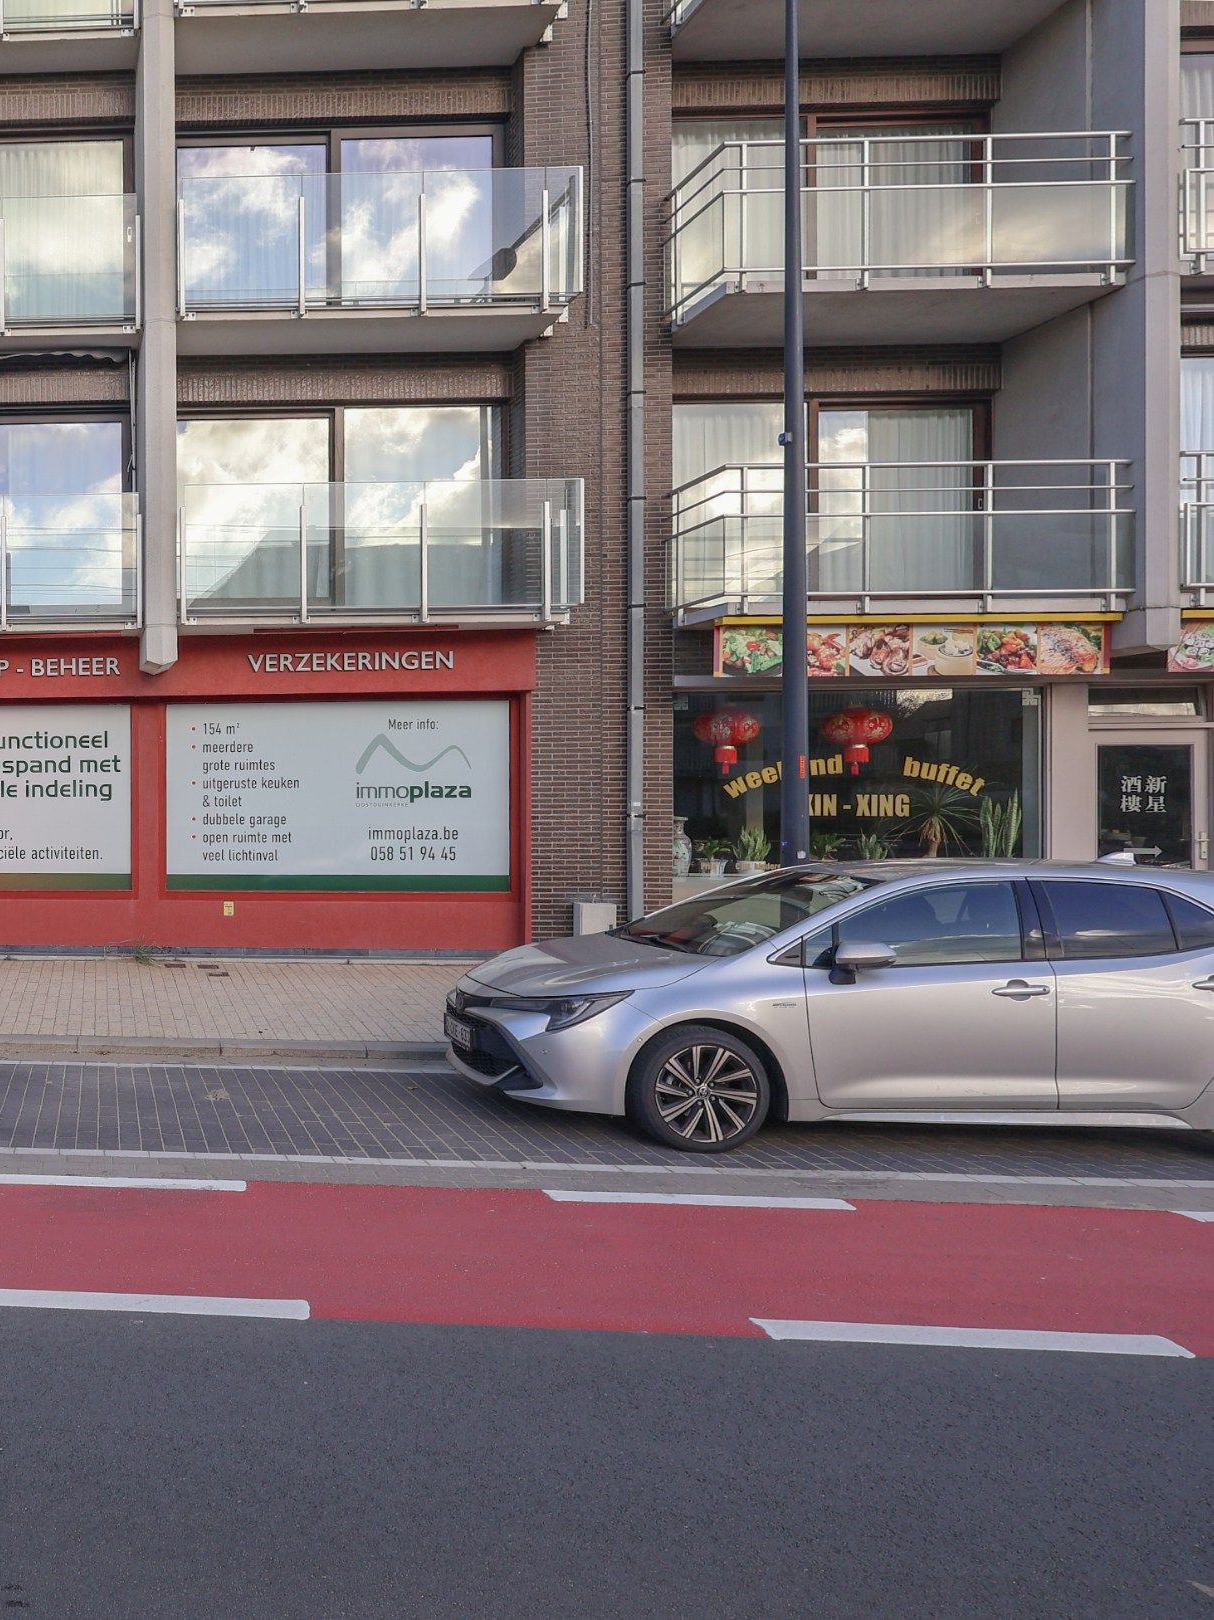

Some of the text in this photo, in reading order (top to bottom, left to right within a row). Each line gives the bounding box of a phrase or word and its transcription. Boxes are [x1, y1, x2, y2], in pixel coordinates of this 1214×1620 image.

[30, 657, 121, 677] BEHEER
[247, 651, 454, 673] VERZEKERINGEN
[202, 723, 222, 735] 154
[388, 718, 439, 731] Meer info:
[202, 741, 253, 753] meerdere
[79, 755, 122, 774] met
[202, 759, 275, 774] grote ruimtes
[202, 777, 300, 792] uitgeruste keuken
[722, 754, 843, 799] weend
[903, 756, 985, 797] buffet
[25, 779, 113, 802] indeling
[356, 781, 472, 803] immoplaza
[202, 795, 242, 808] & toilet
[856, 794, 910, 817] XING
[202, 813, 287, 829] dubbele garage
[202, 831, 293, 847] open ruimte met
[368, 826, 459, 844] immoplaza.be
[30, 845, 103, 860] activiteiten.
[202, 849, 279, 862] veel lichtinval
[370, 846, 456, 861] 058 51 94 45
